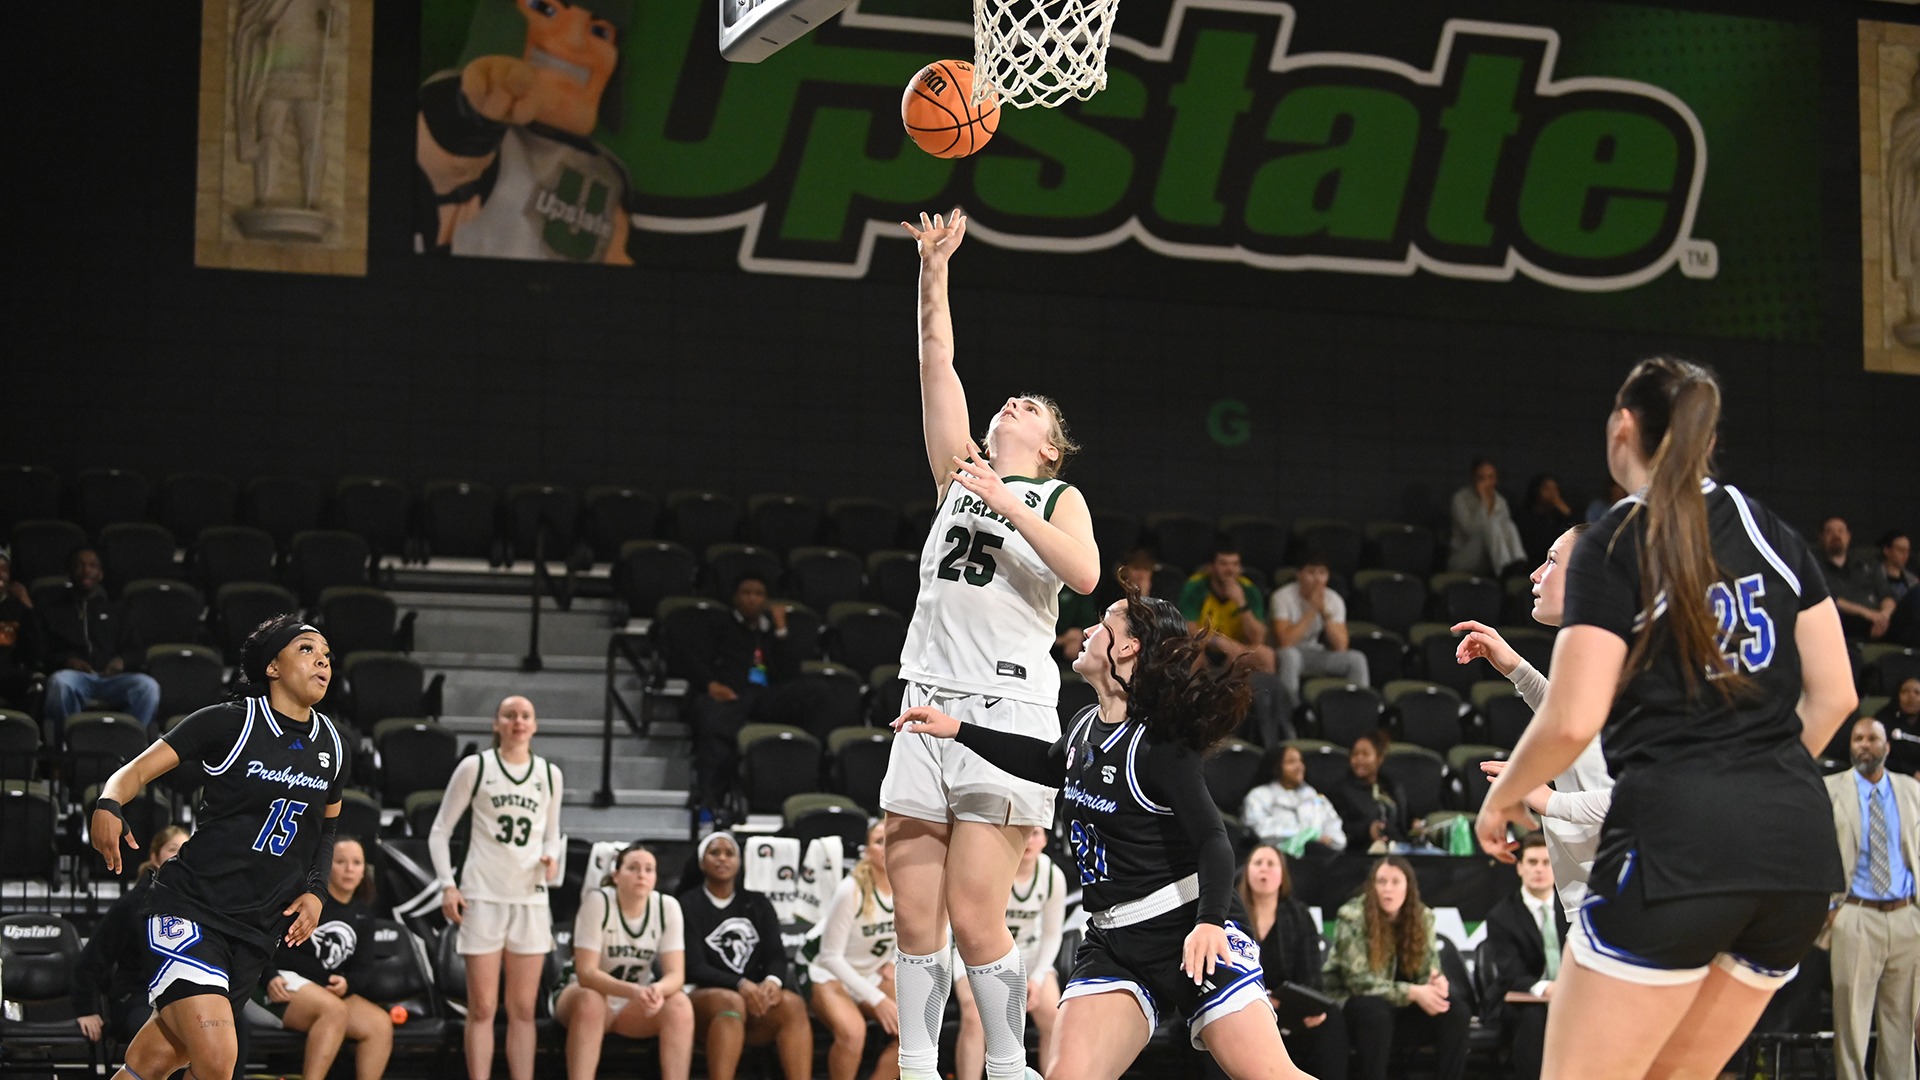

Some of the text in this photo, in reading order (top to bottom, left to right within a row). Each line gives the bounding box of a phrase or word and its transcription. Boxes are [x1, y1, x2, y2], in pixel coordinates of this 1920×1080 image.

[605, 0, 1679, 258] Upstate
[536, 190, 611, 239] Upstate
[1687, 249, 1710, 266] TM
[1208, 400, 1251, 446] G
[937, 525, 1004, 587] 25
[1705, 573, 1776, 681] 25
[246, 760, 328, 791] Presbyterian
[252, 798, 309, 856] 15
[491, 794, 538, 813] UPSTATE
[495, 815, 531, 847] 33
[1071, 819, 1113, 886] 21
[3, 924, 61, 940] Upstate
